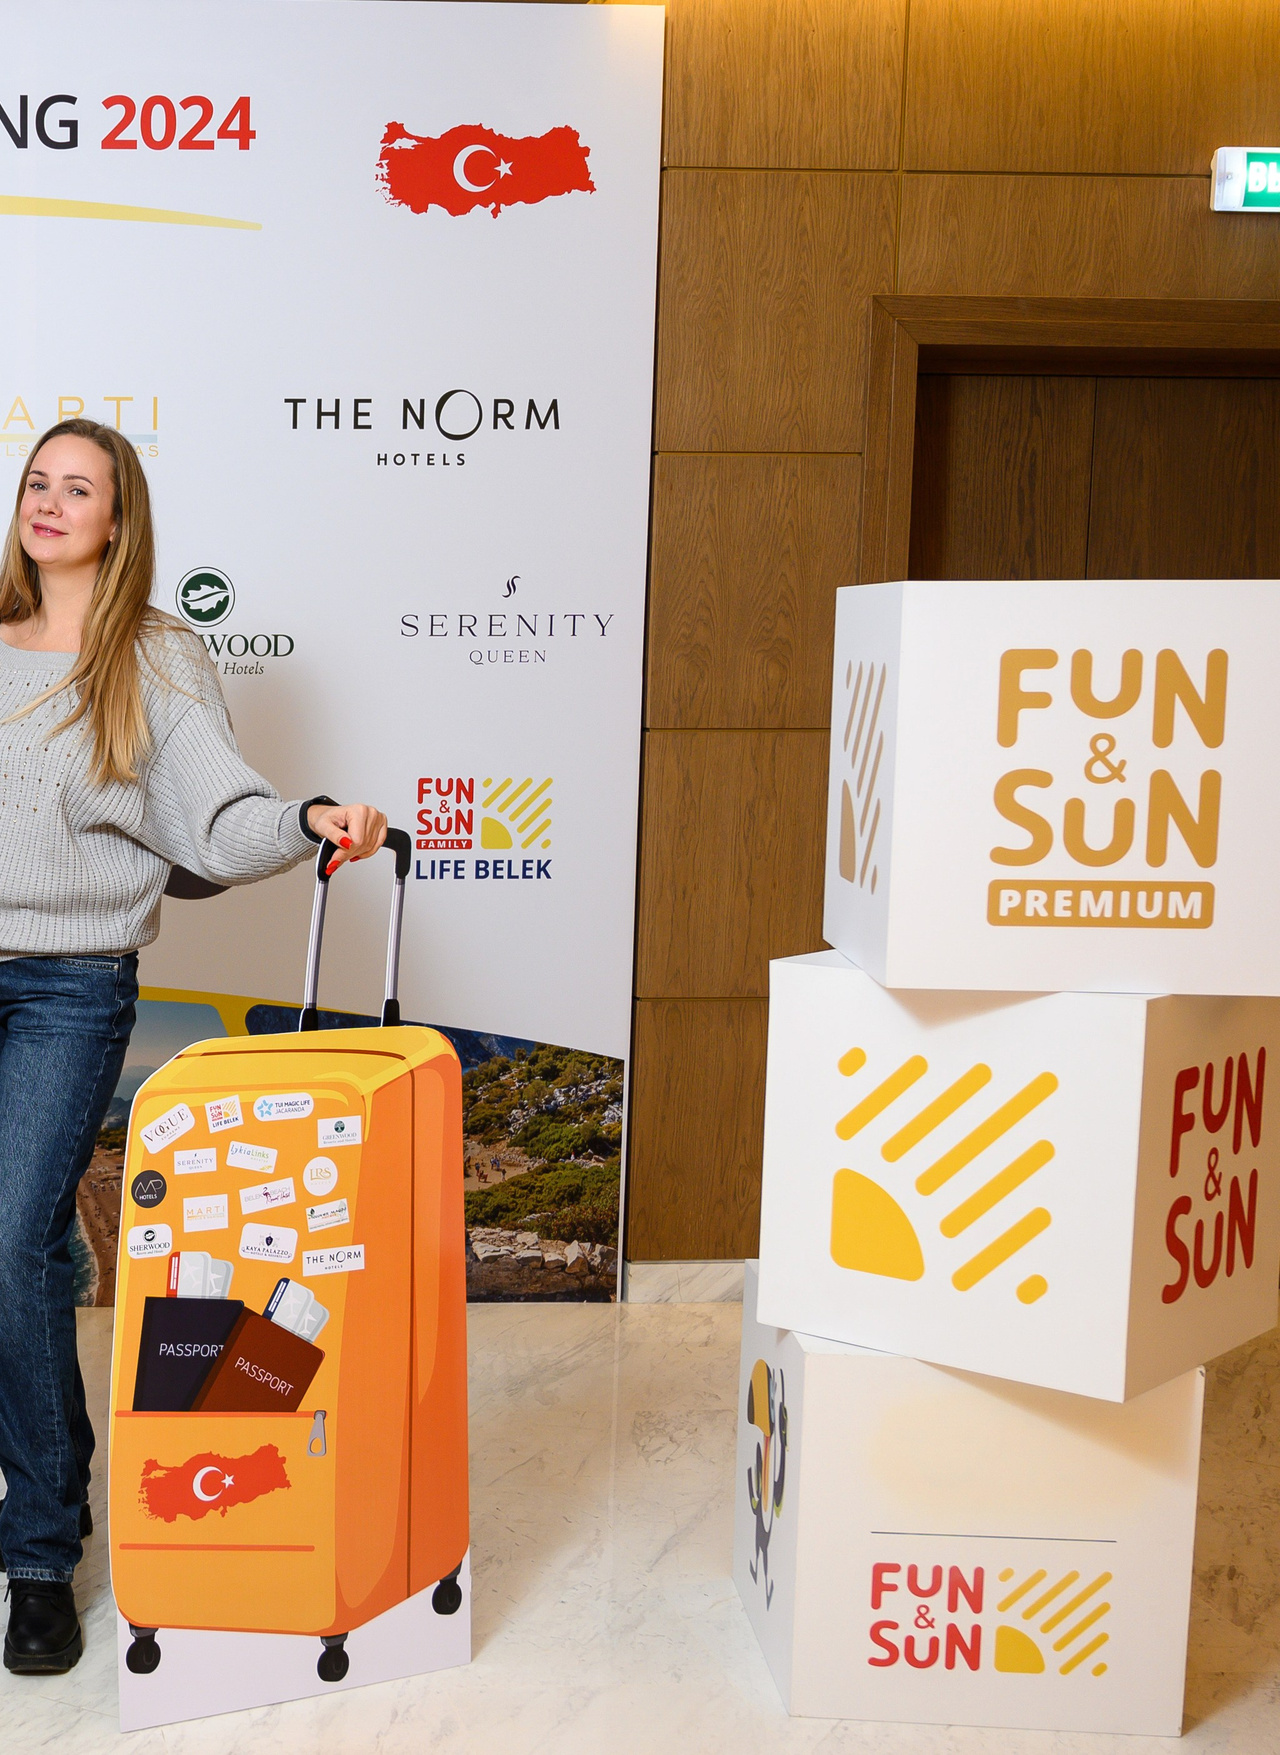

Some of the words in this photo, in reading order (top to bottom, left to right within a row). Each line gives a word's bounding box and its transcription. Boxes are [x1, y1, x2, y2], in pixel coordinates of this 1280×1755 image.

[100, 95, 256, 151] 2024
[284, 398, 372, 430] THE
[402, 389, 561, 441] NORM
[377, 453, 466, 466] HOTELS
[400, 614, 615, 637] SERENITY
[223, 661, 265, 675] Hotels
[469, 650, 547, 666] QUEEN
[997, 648, 1229, 749] FUN
[1084, 732, 1127, 784] &
[417, 777, 474, 804] FUN
[439, 800, 450, 813] &
[989, 768, 1222, 869] SUN
[416, 808, 473, 835] SUN
[421, 840, 468, 848] FAMILY
[415, 859, 466, 880] LIFE
[475, 859, 552, 880] BELEK
[998, 889, 1202, 920] PREMIUM
[212, 1120, 223, 1128] LIFE
[223, 1116, 239, 1125] BELEK
[275, 1107, 305, 1115] JACARANDA
[1169, 1046, 1266, 1178] FUN
[143, 1108, 189, 1142] VOGUE
[322, 1132, 357, 1140] GREENWOOD
[176, 1158, 214, 1166] SERENITY
[309, 1167, 332, 1181] LRS
[1204, 1147, 1222, 1201] &
[186, 1205, 225, 1216] MARTI
[129, 1242, 170, 1253] SHERWOOD
[1161, 1168, 1258, 1304] SUN
[246, 1245, 261, 1253] KAYA
[262, 1247, 289, 1256] PALAZZO
[306, 1254, 324, 1264] THE
[329, 1250, 361, 1263] NORM
[234, 1356, 295, 1396] PASSPORT
[870, 1562, 985, 1614] FUN
[913, 1604, 936, 1630] &
[867, 1619, 982, 1671] SUN
